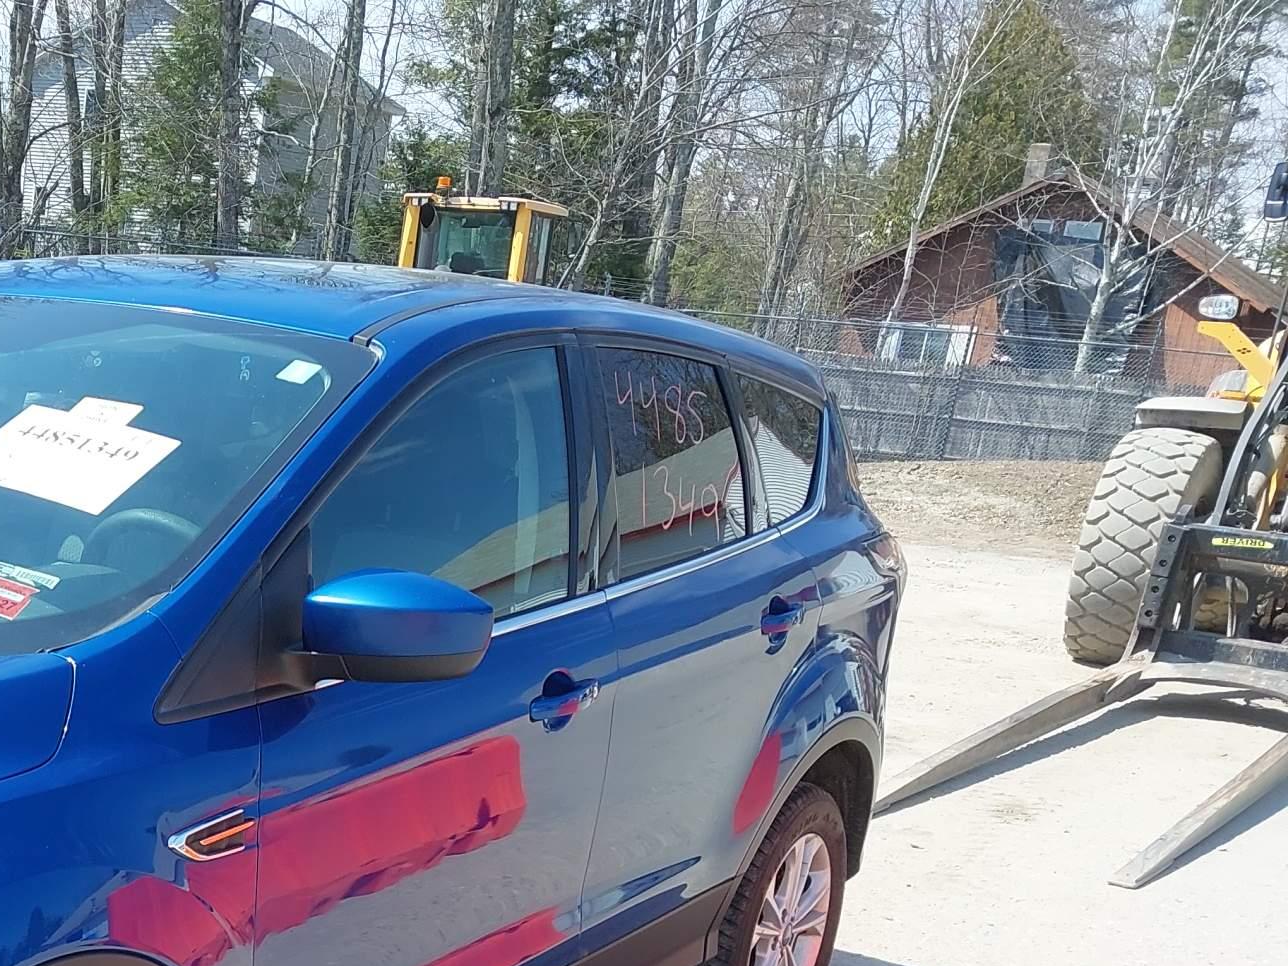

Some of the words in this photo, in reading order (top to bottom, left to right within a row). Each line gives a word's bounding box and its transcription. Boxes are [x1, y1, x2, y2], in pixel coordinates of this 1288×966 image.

[614, 370, 708, 445] 4485
[17, 424, 140, 463] 44851349
[641, 462, 720, 542] 1349
[1221, 536, 1267, 548] DRIVER
